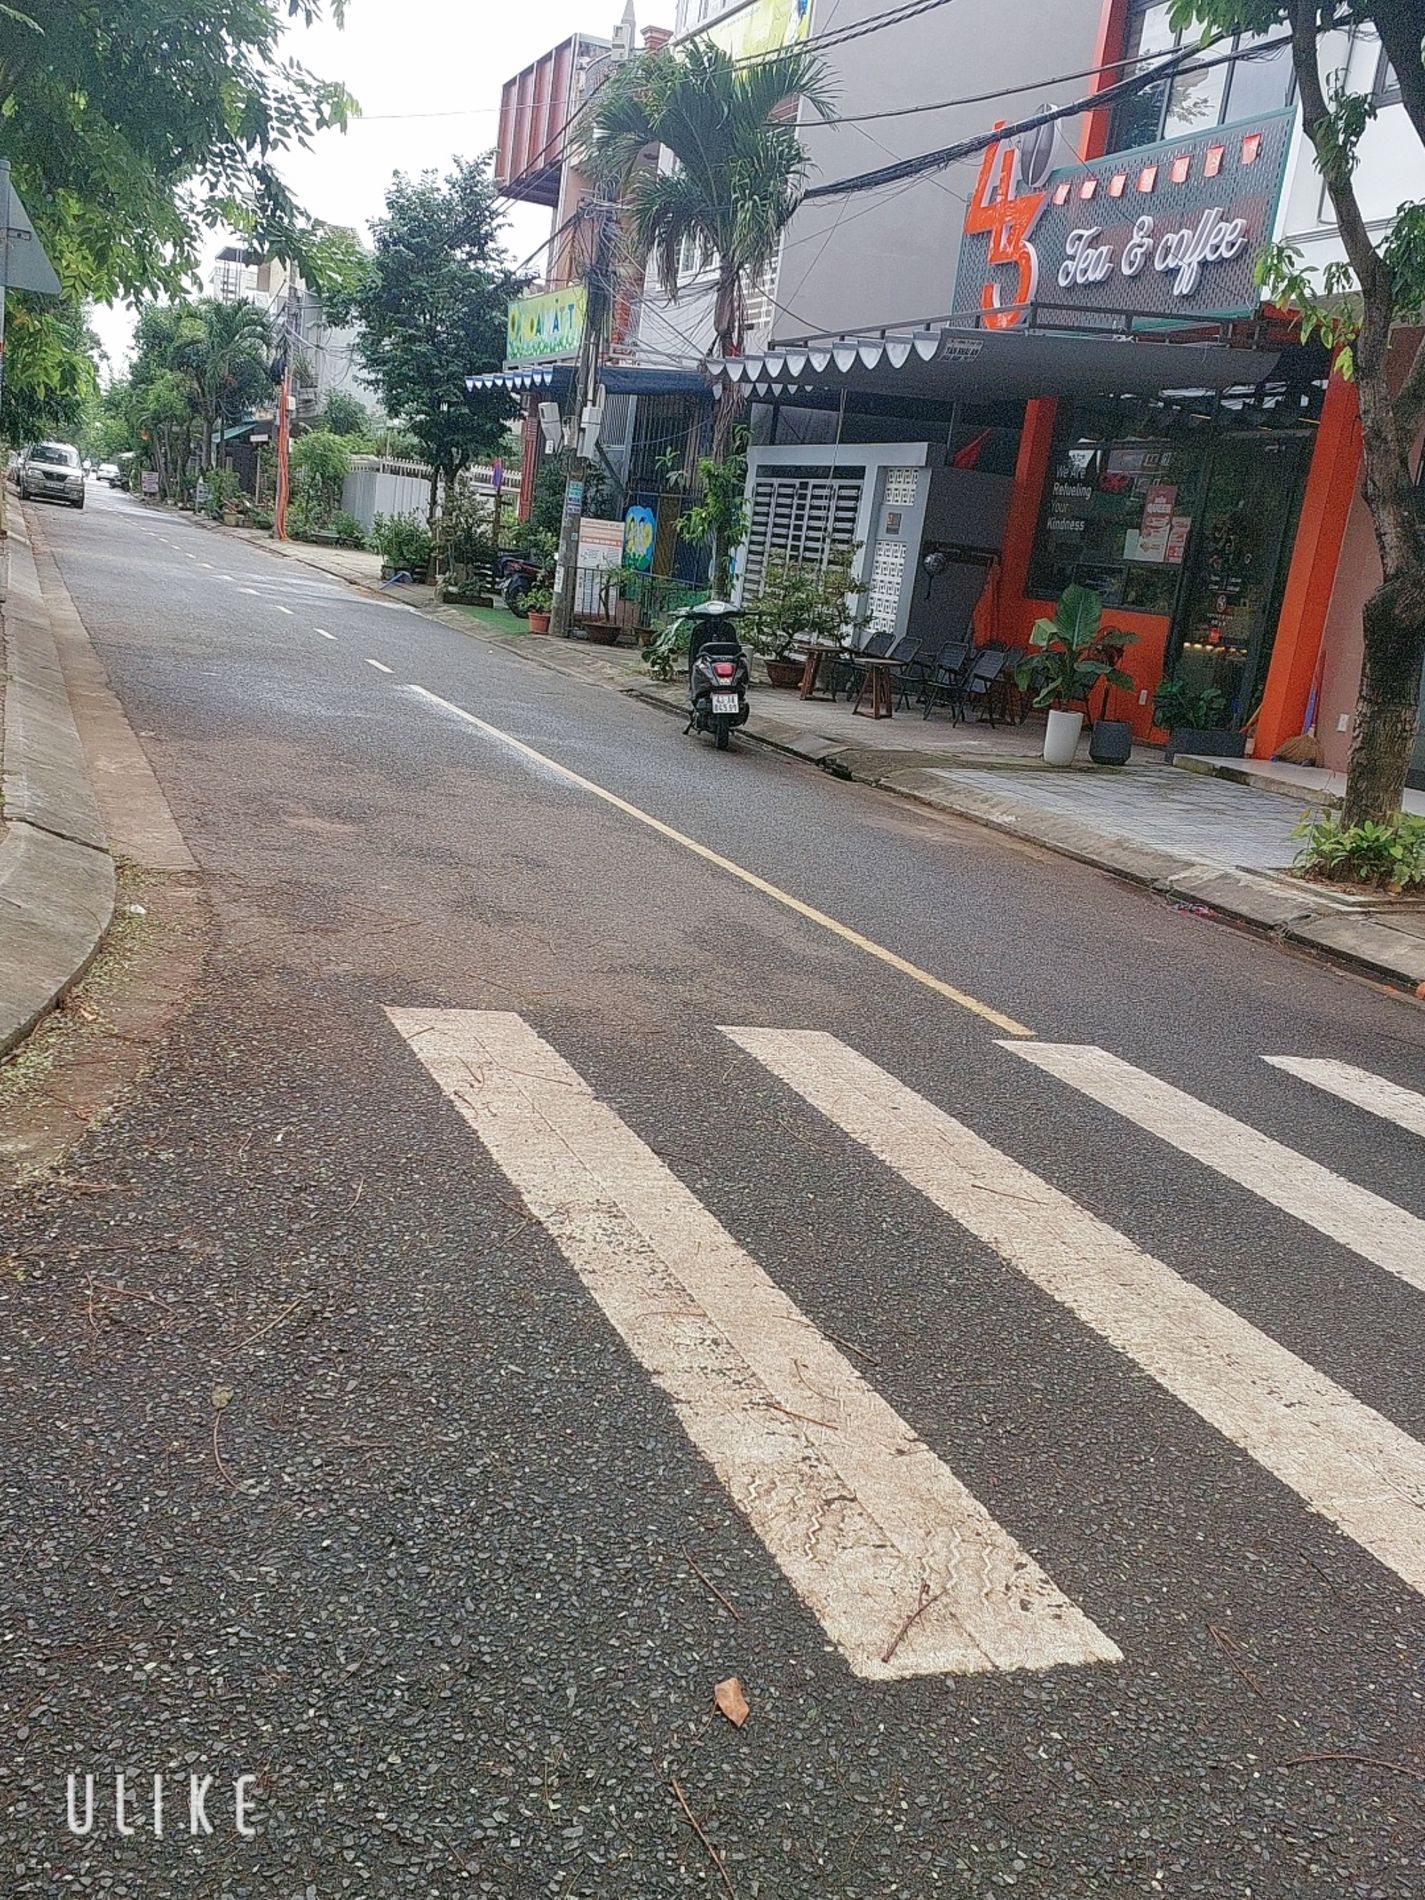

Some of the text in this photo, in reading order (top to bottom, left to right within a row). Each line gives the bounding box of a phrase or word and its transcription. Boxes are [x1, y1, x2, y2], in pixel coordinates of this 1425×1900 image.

[1058, 207, 1248, 296] Tea & coffee
[1053, 482, 1092, 500] Refueling
[1047, 516, 1085, 531] Kindness
